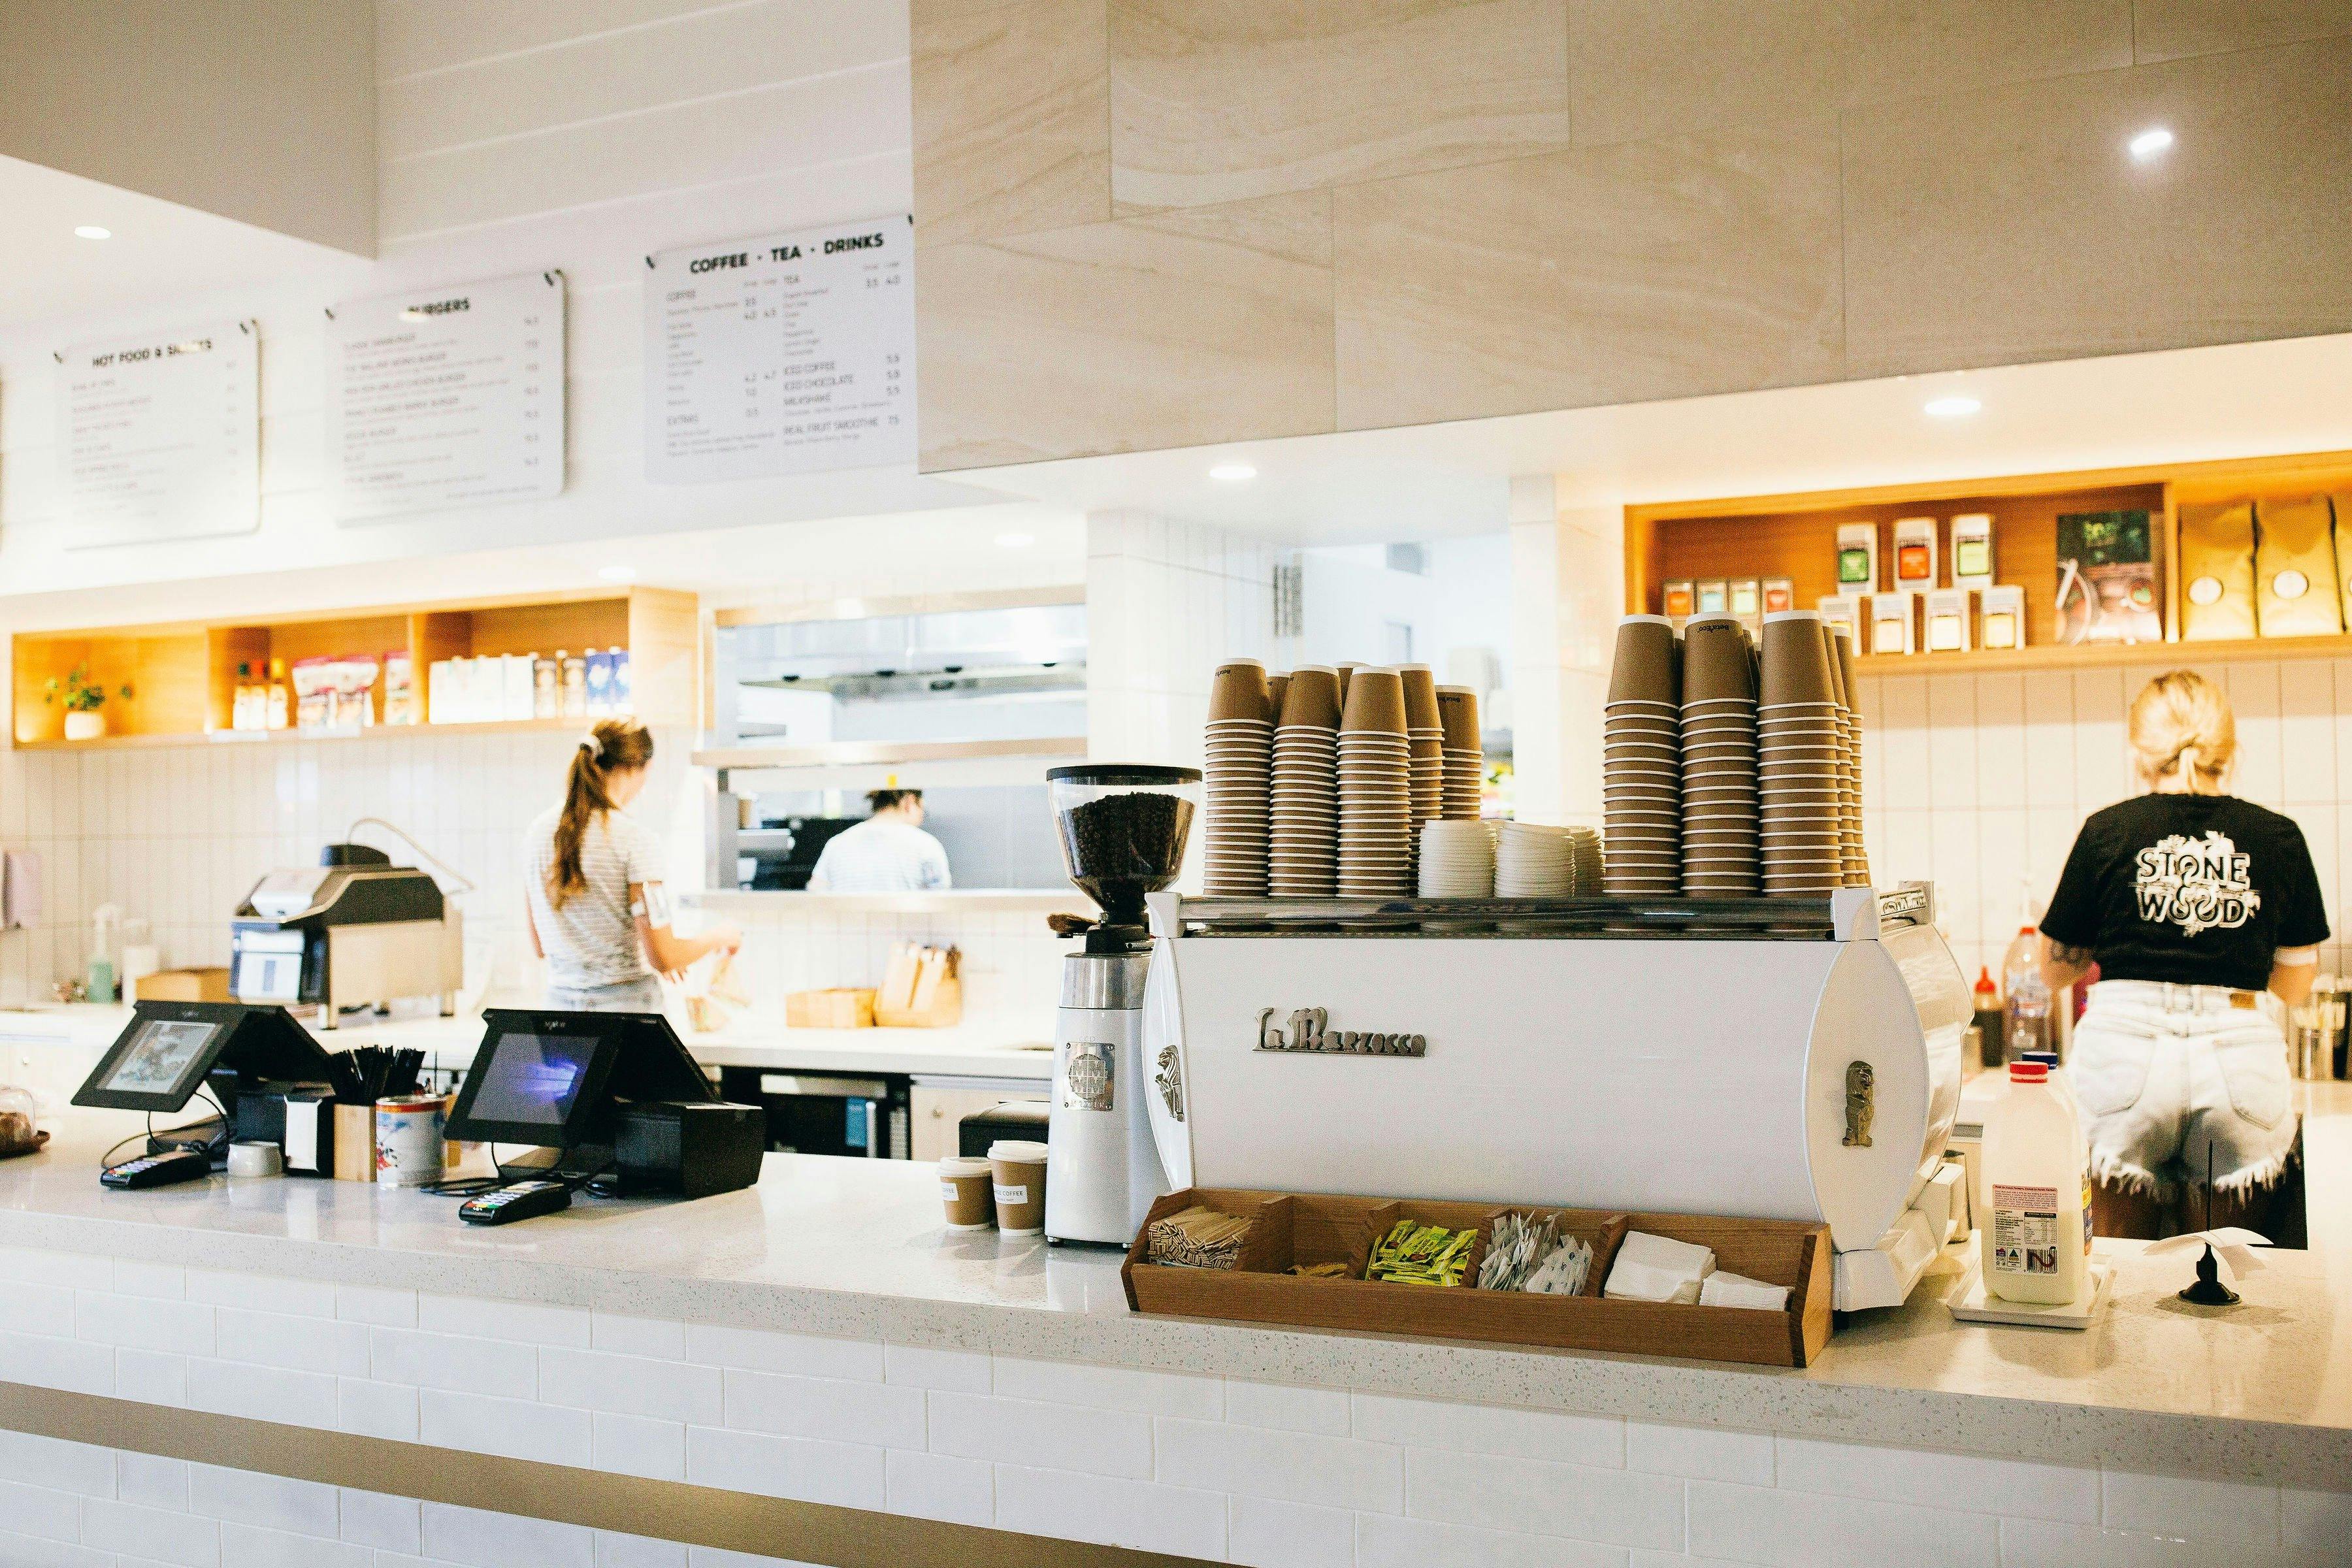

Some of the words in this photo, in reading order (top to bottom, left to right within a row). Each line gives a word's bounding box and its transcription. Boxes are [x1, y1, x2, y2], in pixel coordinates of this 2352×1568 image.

[690, 253, 748, 274] COFFEE
[770, 246, 802, 262] TEA
[824, 233, 884, 255] DRINKS
[92, 353, 114, 368] HOT
[119, 348, 151, 363] FOOD
[2138, 849, 2251, 888] STONE
[2138, 887, 2247, 926] WOOD
[1252, 1007, 1284, 1052] La
